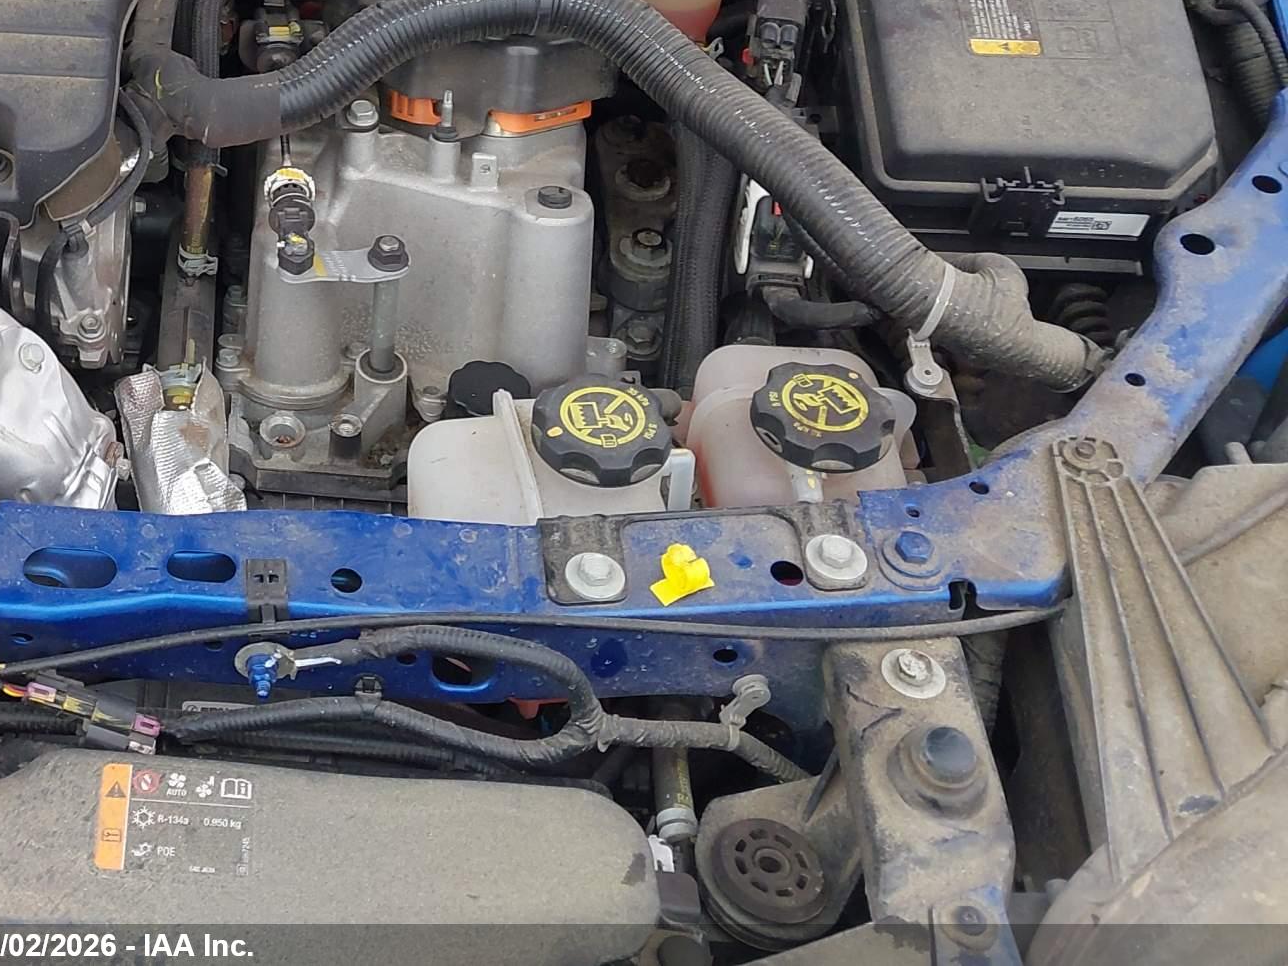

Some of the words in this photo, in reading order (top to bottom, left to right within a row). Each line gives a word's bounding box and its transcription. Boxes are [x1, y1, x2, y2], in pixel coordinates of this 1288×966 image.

[166, 788, 187, 797] AUTO
[157, 814, 190, 825] R-134a
[230, 818, 242, 830] kg
[157, 846, 176, 857] POE
